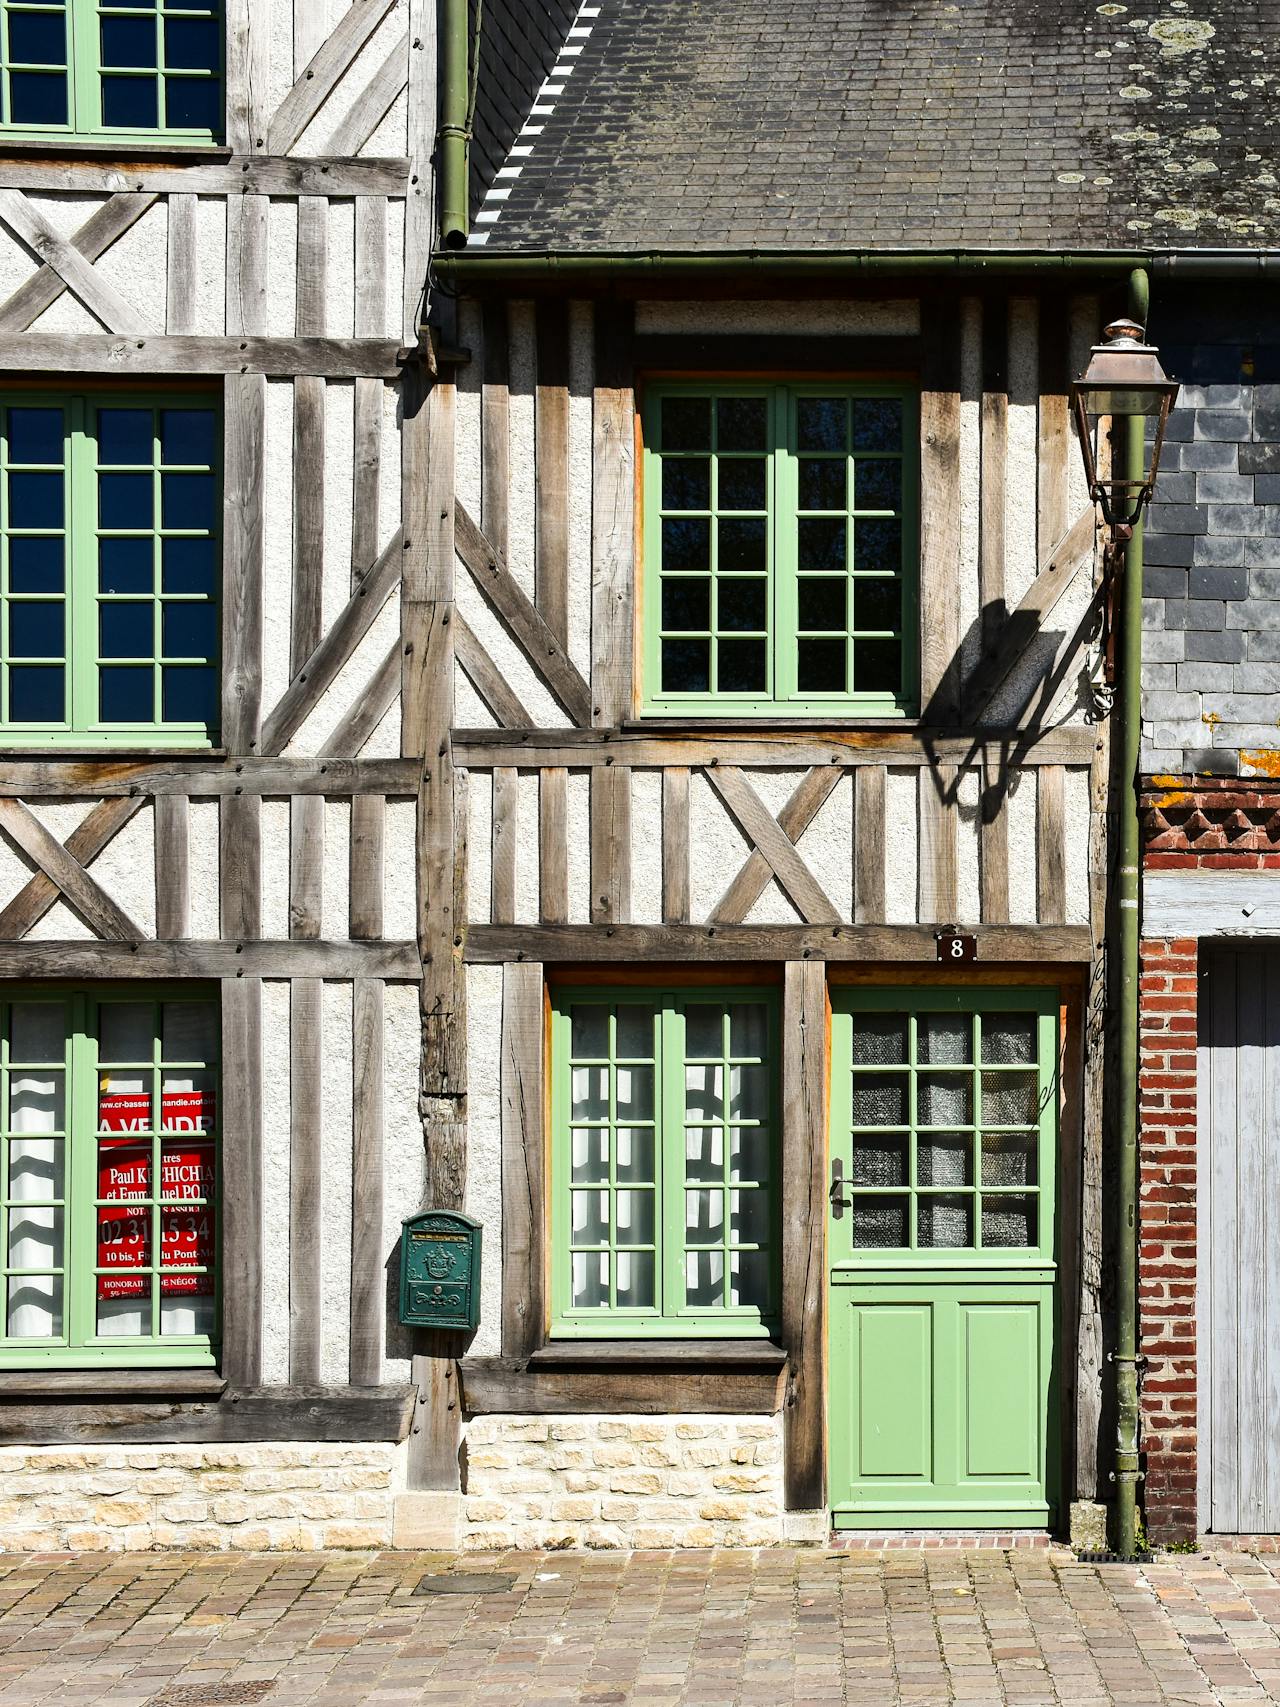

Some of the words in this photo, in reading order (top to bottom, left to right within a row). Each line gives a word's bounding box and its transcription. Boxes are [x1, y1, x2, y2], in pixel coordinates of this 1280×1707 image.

[951, 939, 964, 958] 8
[119, 1116, 214, 1132] VENDR
[109, 1167, 136, 1185] Paul
[106, 1189, 117, 1200] et
[101, 1219, 123, 1245] 02
[128, 1218, 151, 1245] 31
[185, 1216, 210, 1243] 34
[105, 1251, 117, 1262] 10
[119, 1251, 135, 1263] bis,
